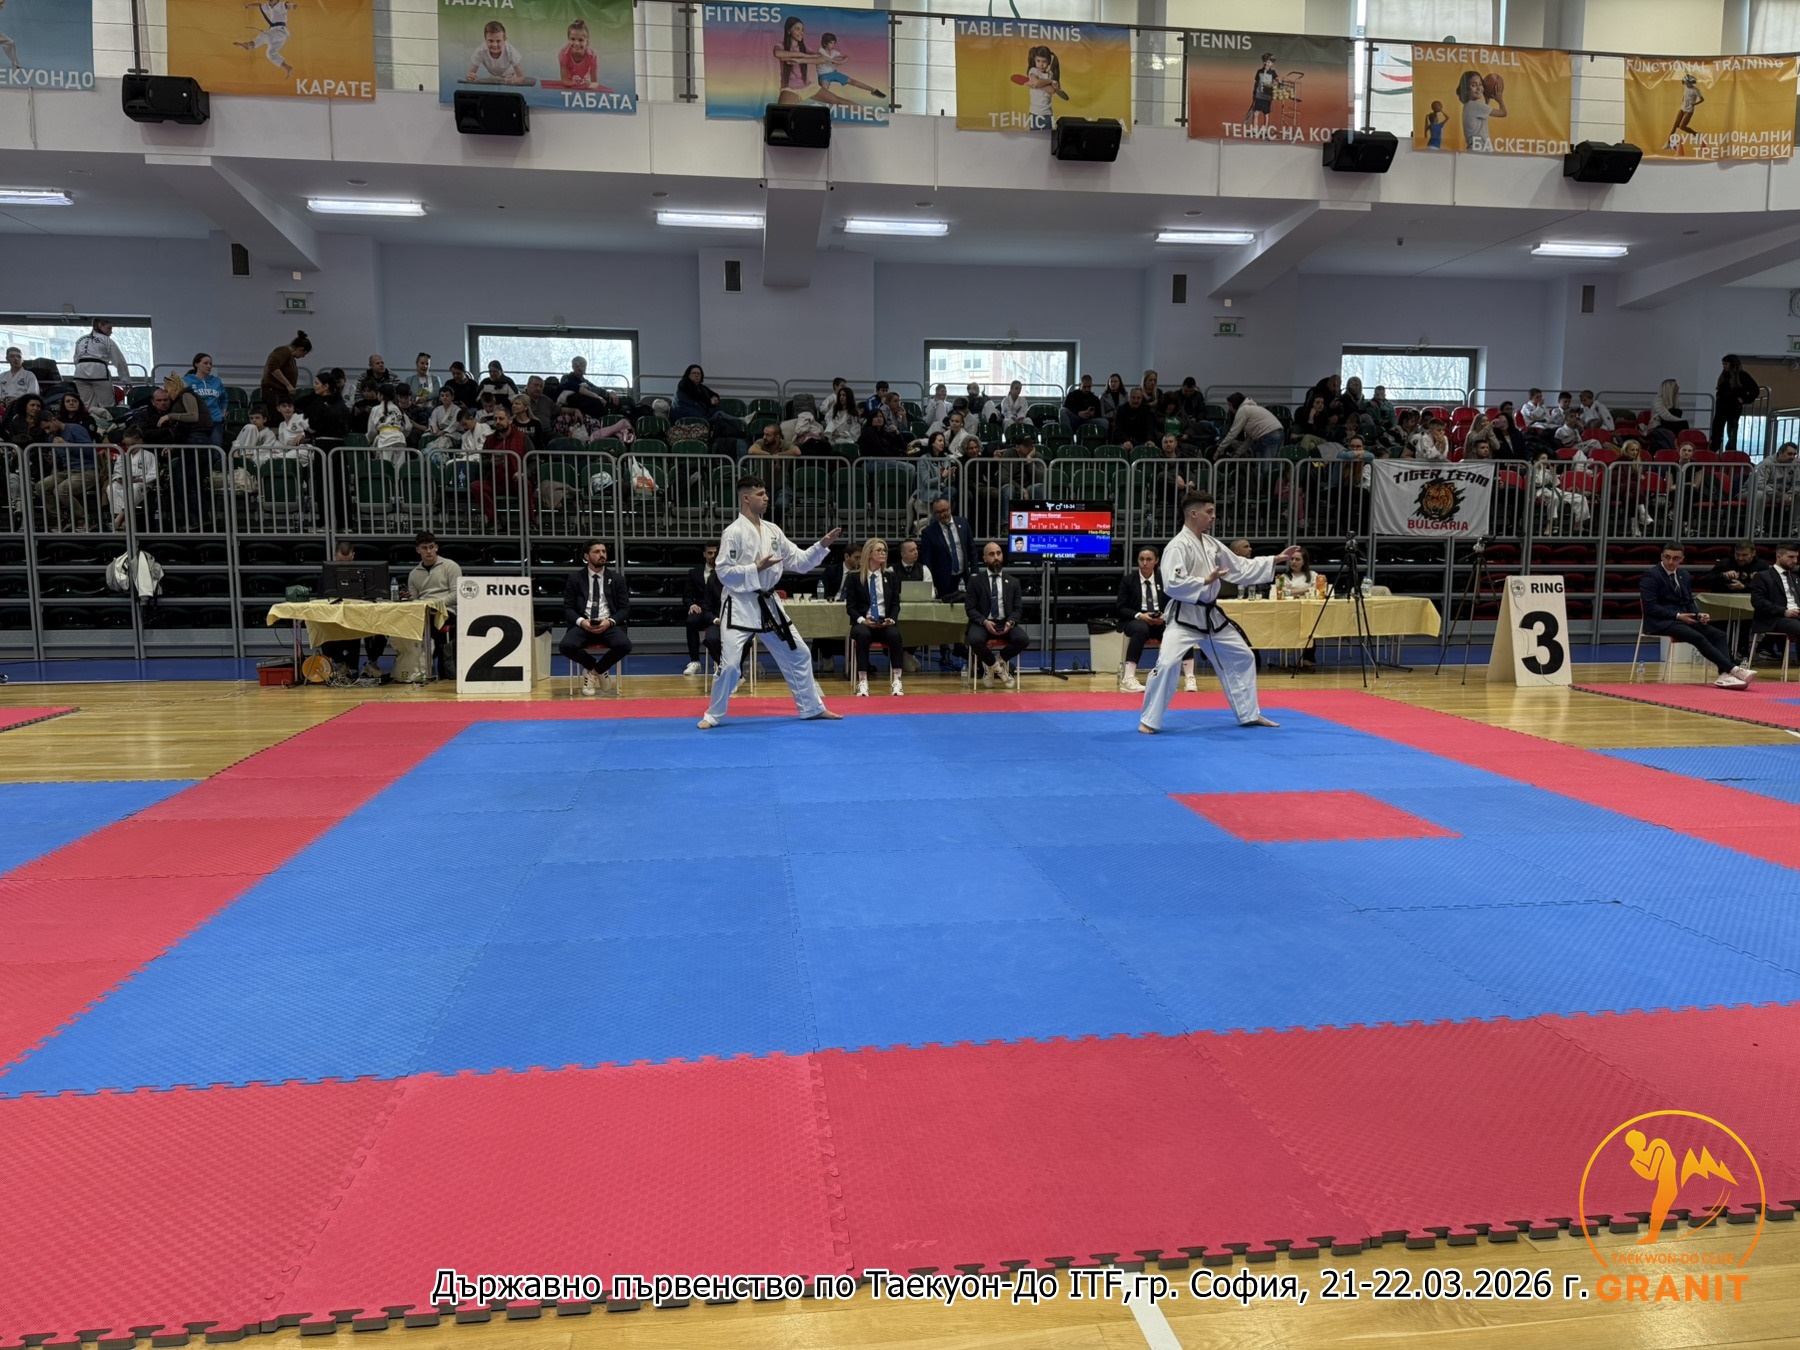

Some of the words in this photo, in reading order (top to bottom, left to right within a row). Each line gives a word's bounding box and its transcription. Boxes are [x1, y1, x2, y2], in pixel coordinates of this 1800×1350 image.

[705, 6, 781, 23] FITNESS
[958, 21, 1013, 37] TABLE
[1018, 23, 1081, 42] TENNIS
[1190, 32, 1252, 50] TENNIS
[1414, 47, 1520, 66] BASKETBALL
[1626, 60, 1708, 73] FUNCTIONAL
[1713, 59, 1784, 72] TRAINING
[296, 79, 372, 97] КАРАТЕ
[561, 91, 632, 110] ТАБАТА
[813, 103, 885, 121] ИТНЕС
[989, 111, 1046, 129] ТЕНИС
[1223, 122, 1277, 139] ТЕНИС
[1282, 126, 1305, 142] НА
[1670, 130, 1792, 146] ФУНКЦИОНАЛНИ
[1472, 136, 1571, 155] БАСКЕТБОЛ
[1693, 145, 1791, 158] ТРЕНИРОВКИ
[1393, 469, 1442, 484] TIGER
[1444, 469, 1490, 488] TEAM
[1407, 519, 1469, 531] BULGARIA
[486, 584, 530, 596] RING
[1530, 582, 1564, 594] RING
[465, 614, 524, 682] 2
[1519, 610, 1564, 675] 3
